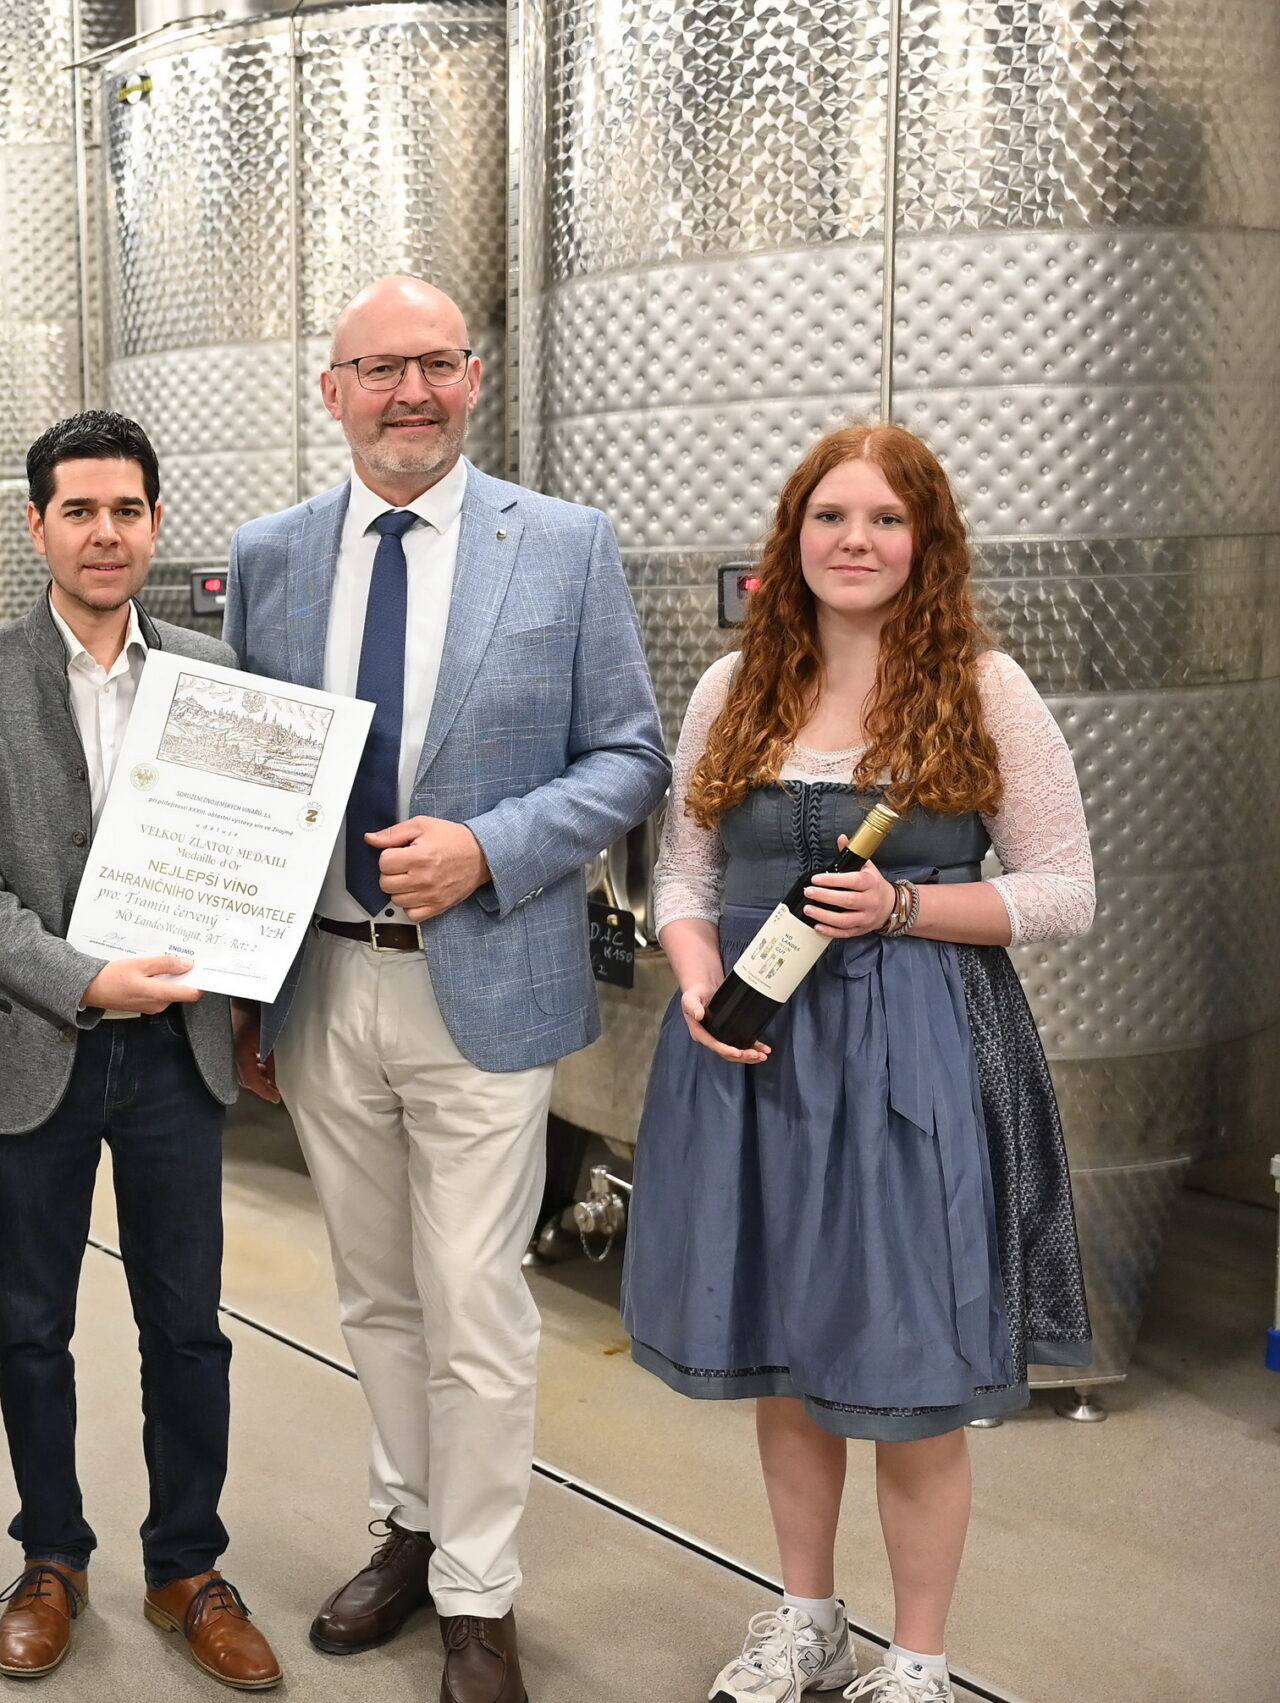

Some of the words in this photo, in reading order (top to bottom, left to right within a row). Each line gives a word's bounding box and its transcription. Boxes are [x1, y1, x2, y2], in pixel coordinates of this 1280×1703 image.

[140, 823, 185, 842] VELKOU
[188, 836, 233, 855] ZLATOU
[236, 848, 286, 868] MEDAILI
[177, 847, 216, 864] Medaille
[147, 859, 220, 887] NEJLEPŠÍ
[223, 877, 258, 896] VÍNO
[98, 865, 194, 900] ZAHRANIČNÍHO
[197, 891, 296, 928] VYSTAVOVATELE
[173, 904, 218, 931] červený
[168, 944, 194, 955] ZNOJMO
